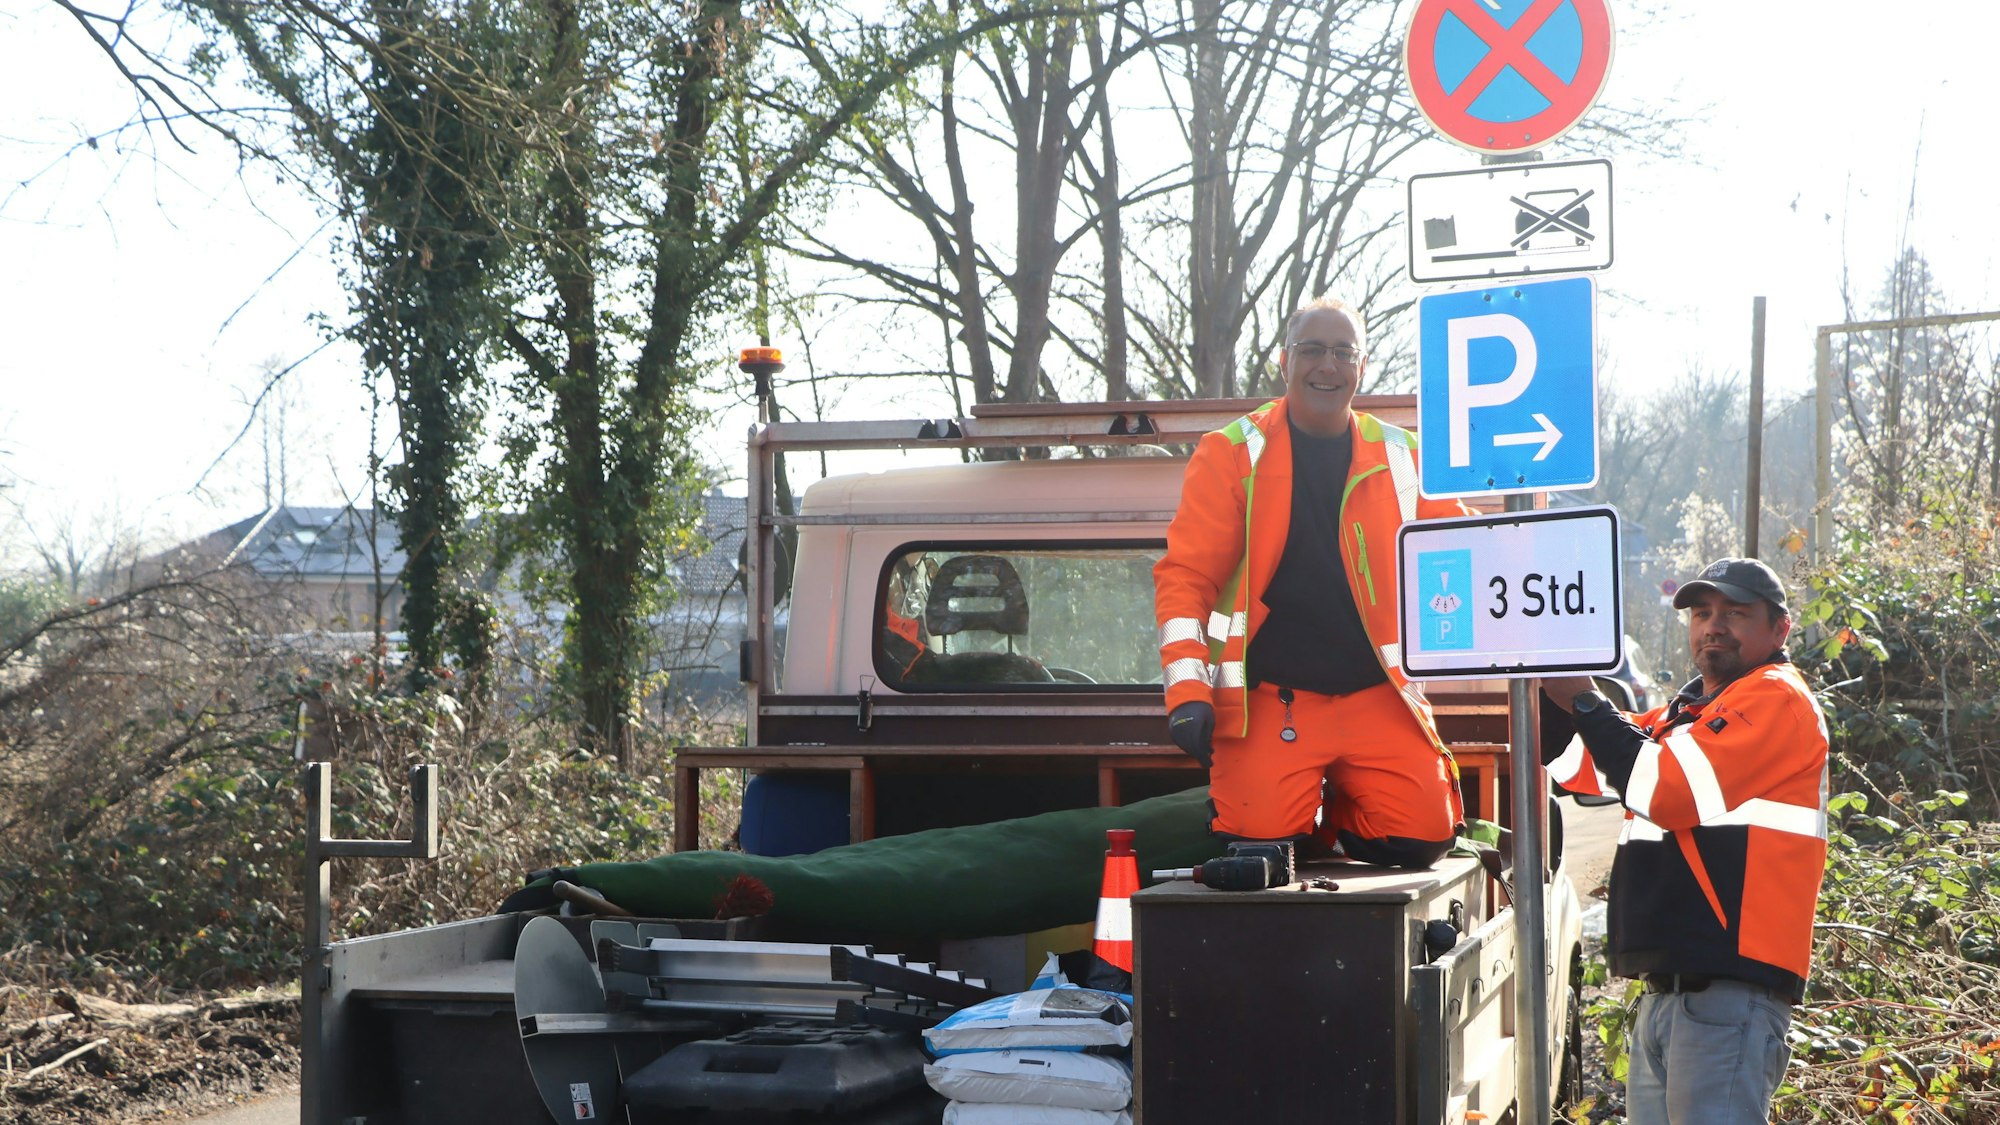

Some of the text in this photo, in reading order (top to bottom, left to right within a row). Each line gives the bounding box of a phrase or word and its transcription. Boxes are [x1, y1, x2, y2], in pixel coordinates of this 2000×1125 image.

[1447, 313, 1538, 468] P
[1488, 570, 1595, 619] 3 Std.
[1440, 619, 1452, 641] P
